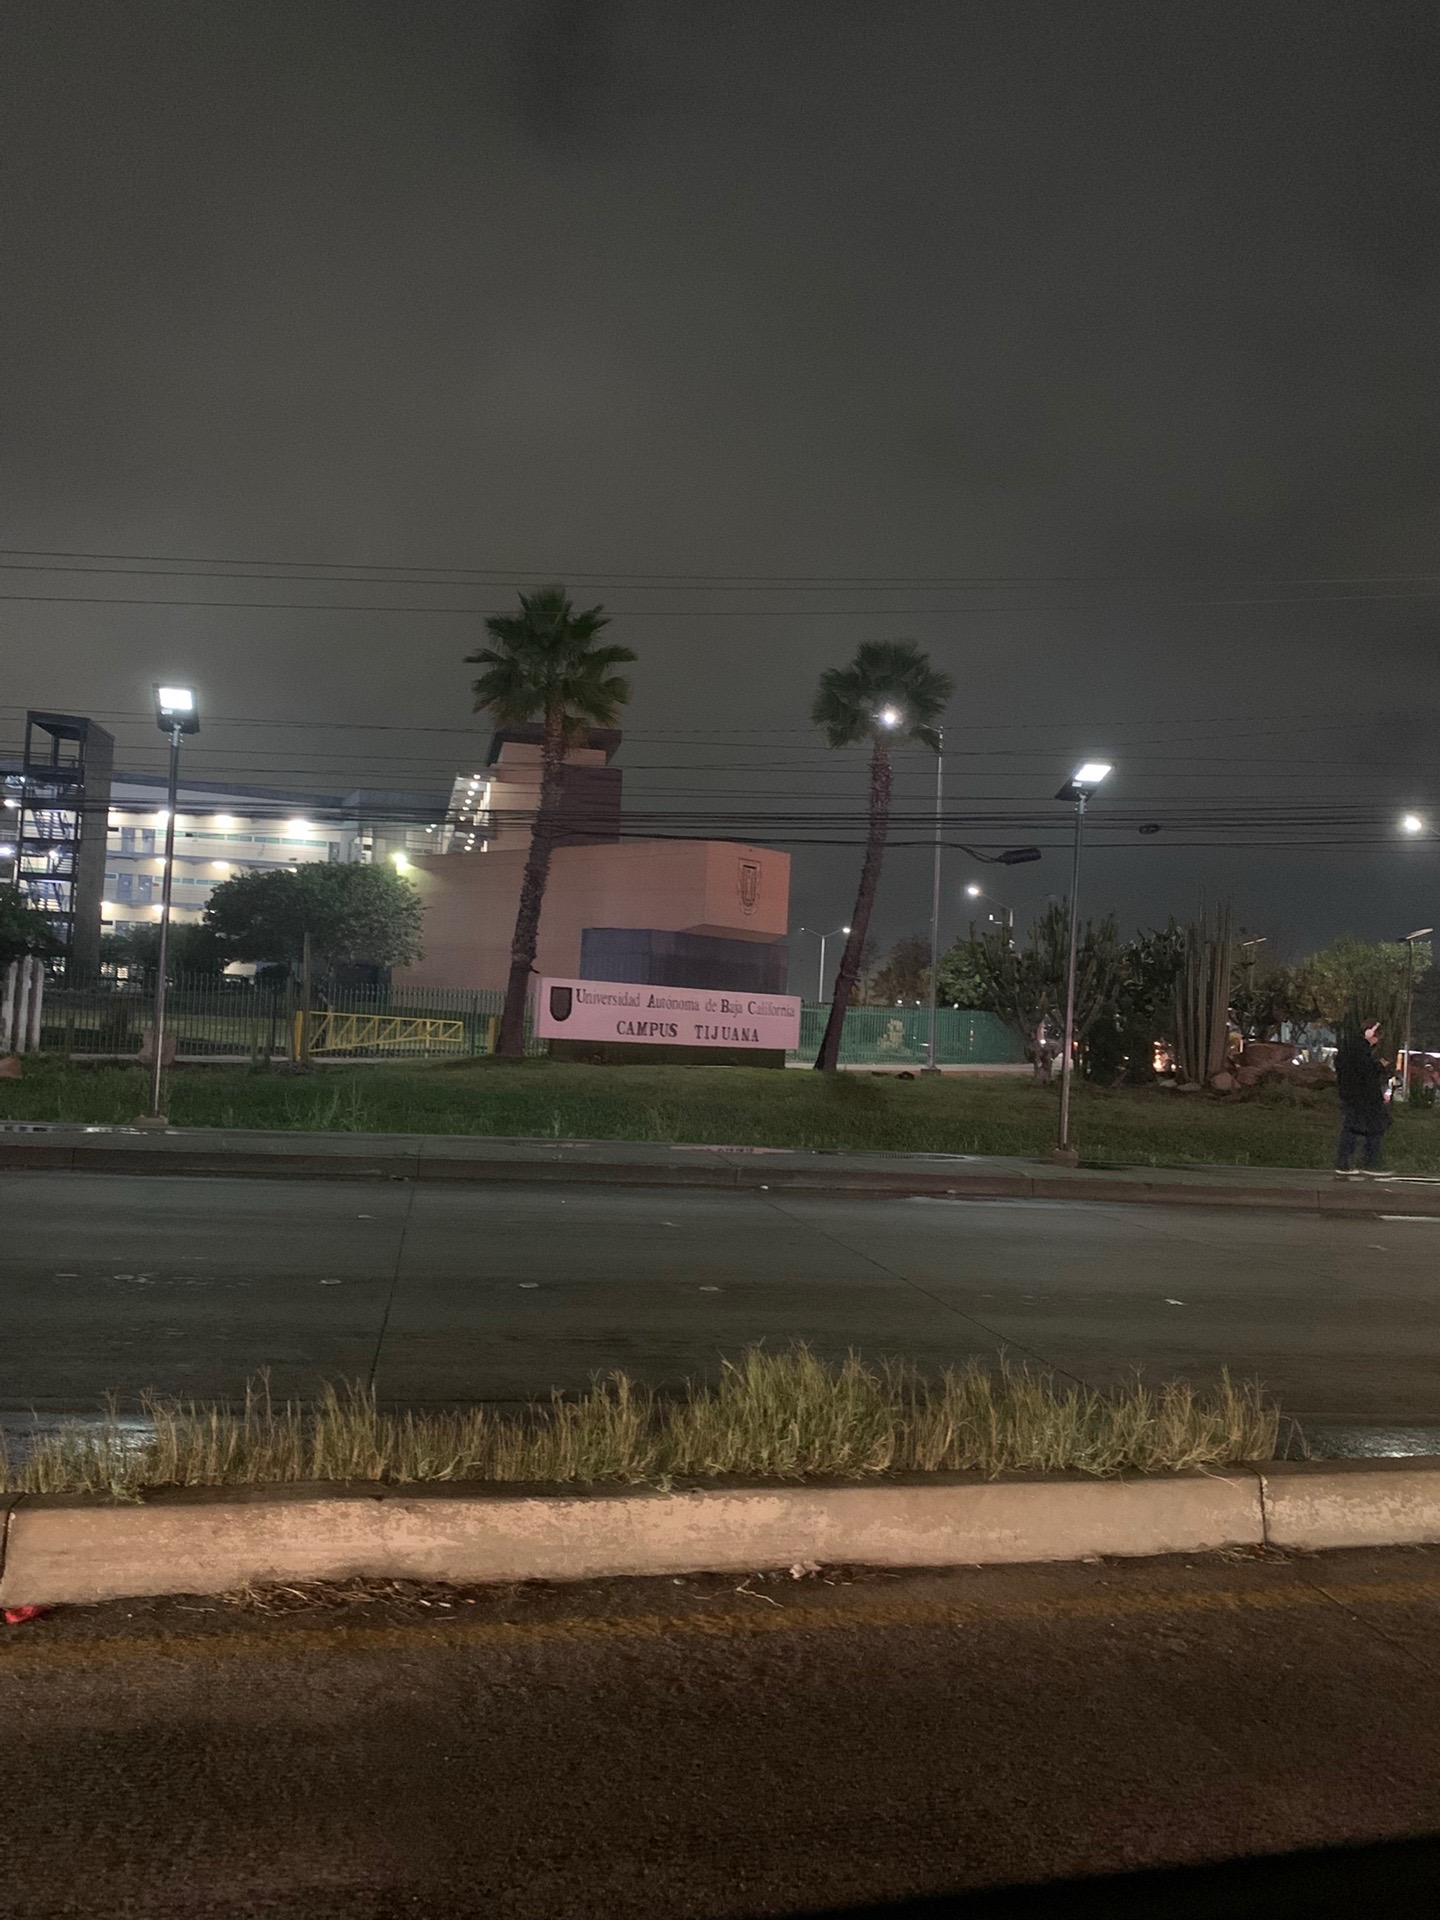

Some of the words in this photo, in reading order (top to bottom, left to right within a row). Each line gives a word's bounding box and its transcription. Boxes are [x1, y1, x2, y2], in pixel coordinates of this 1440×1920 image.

[576, 988, 641, 1007] Universidad
[705, 998, 717, 1012] de
[720, 999, 743, 1018] Baja
[747, 1001, 795, 1017] California
[616, 1020, 678, 1038] CAMPUS
[694, 1025, 760, 1042] TIJUANA
